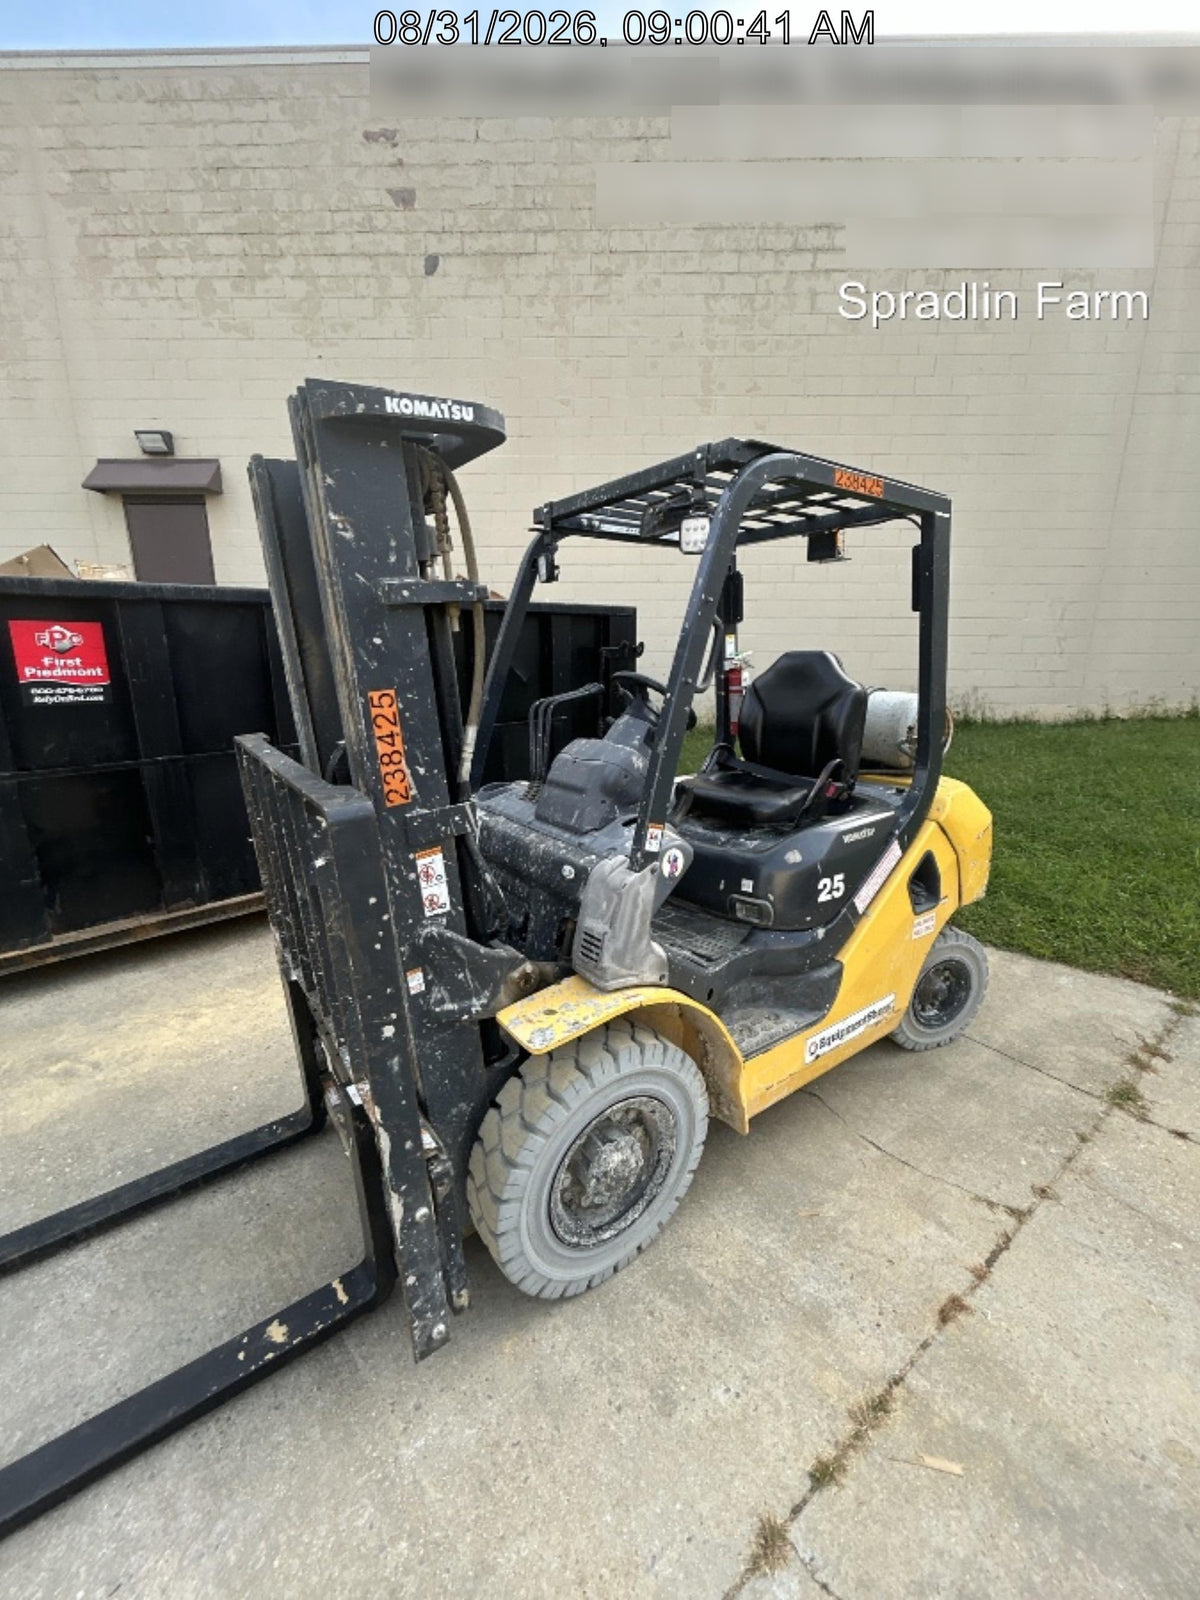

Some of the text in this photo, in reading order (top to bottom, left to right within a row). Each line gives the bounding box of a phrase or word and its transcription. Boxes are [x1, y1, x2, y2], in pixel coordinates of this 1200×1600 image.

[384, 395, 475, 422] KOMATSU
[24, 667, 103, 677] Piedmont
[41, 656, 83, 667] First
[370, 691, 411, 805] 238425
[817, 872, 846, 903] 25
